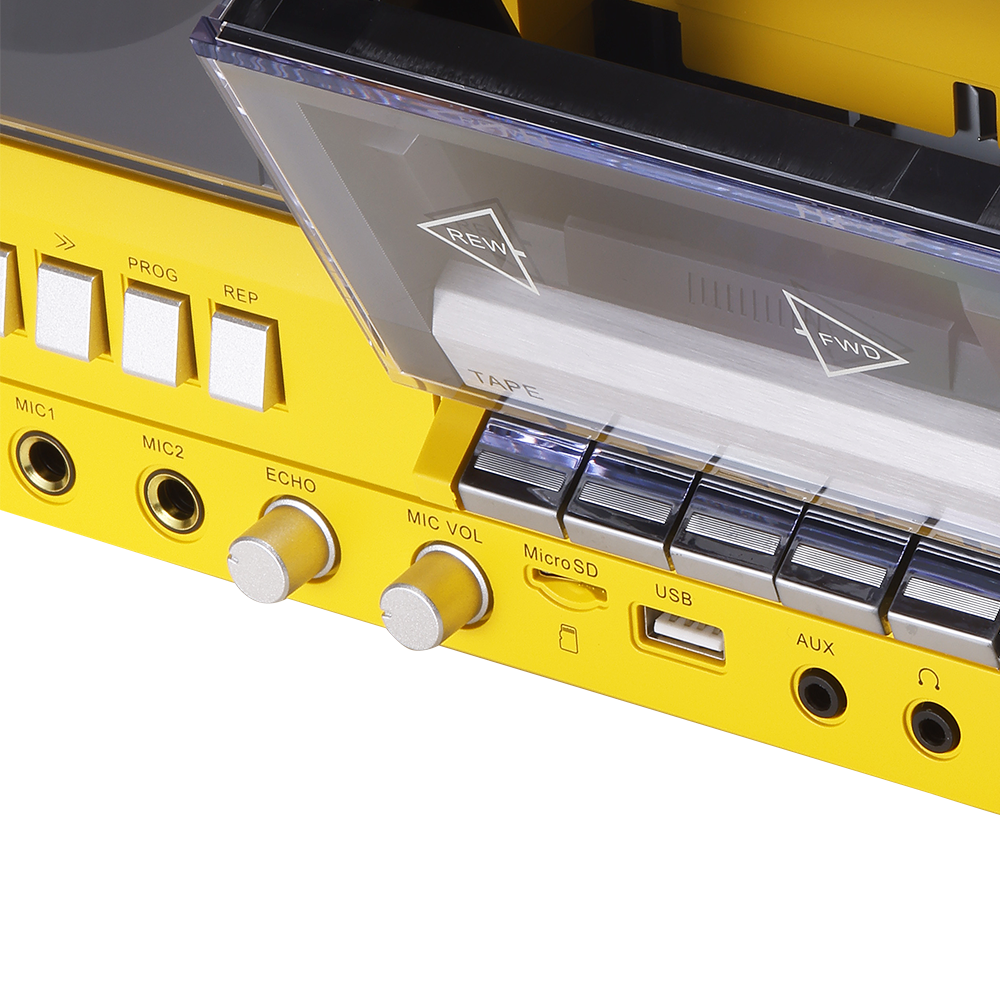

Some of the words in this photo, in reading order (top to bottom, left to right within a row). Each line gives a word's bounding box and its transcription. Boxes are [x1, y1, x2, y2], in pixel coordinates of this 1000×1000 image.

[447, 227, 508, 255] REW
[128, 256, 179, 283] PROG
[223, 284, 259, 305] REP
[817, 332, 882, 361] FWD
[468, 368, 545, 401] TAPE
[15, 396, 56, 421] MIC1
[142, 435, 185, 460] MIC2
[265, 466, 317, 494] ECHO
[407, 509, 442, 533] MIC
[446, 519, 484, 545] VOL
[523, 543, 600, 580] MicroSD
[654, 583, 693, 608] USB
[796, 632, 836, 658] AUX
